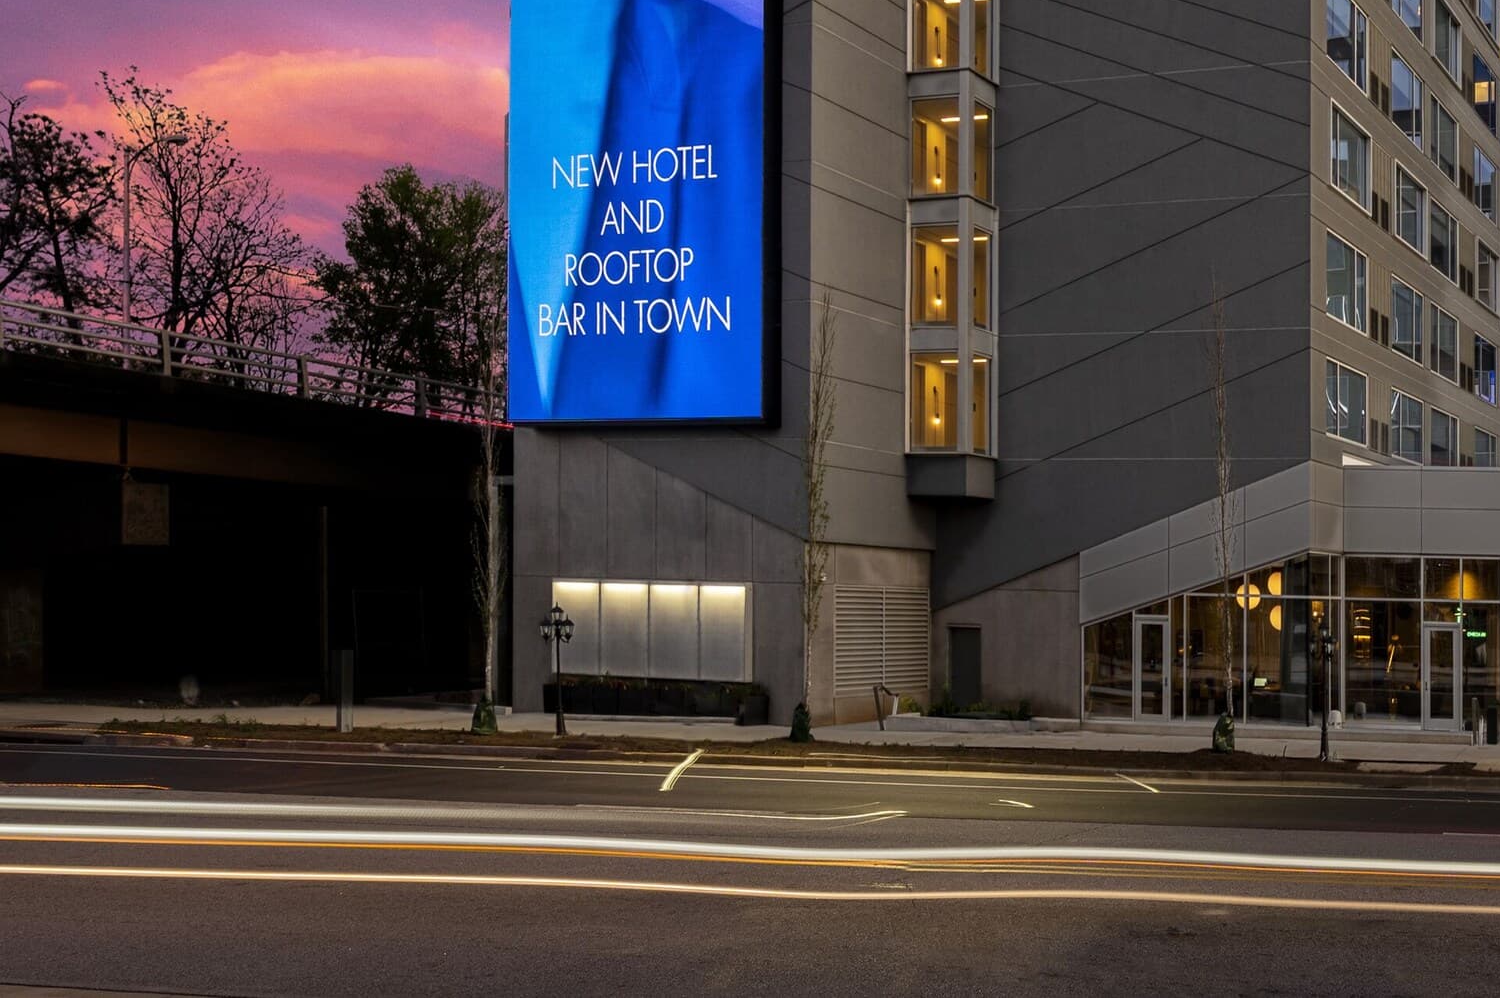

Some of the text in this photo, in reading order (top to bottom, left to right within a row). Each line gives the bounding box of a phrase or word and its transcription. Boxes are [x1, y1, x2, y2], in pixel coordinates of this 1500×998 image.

[552, 144, 718, 189] NEW HOTEL
[600, 199, 665, 236] AND
[564, 247, 694, 287] ROOFTOP
[538, 296, 731, 337] BAR IN TOWN
